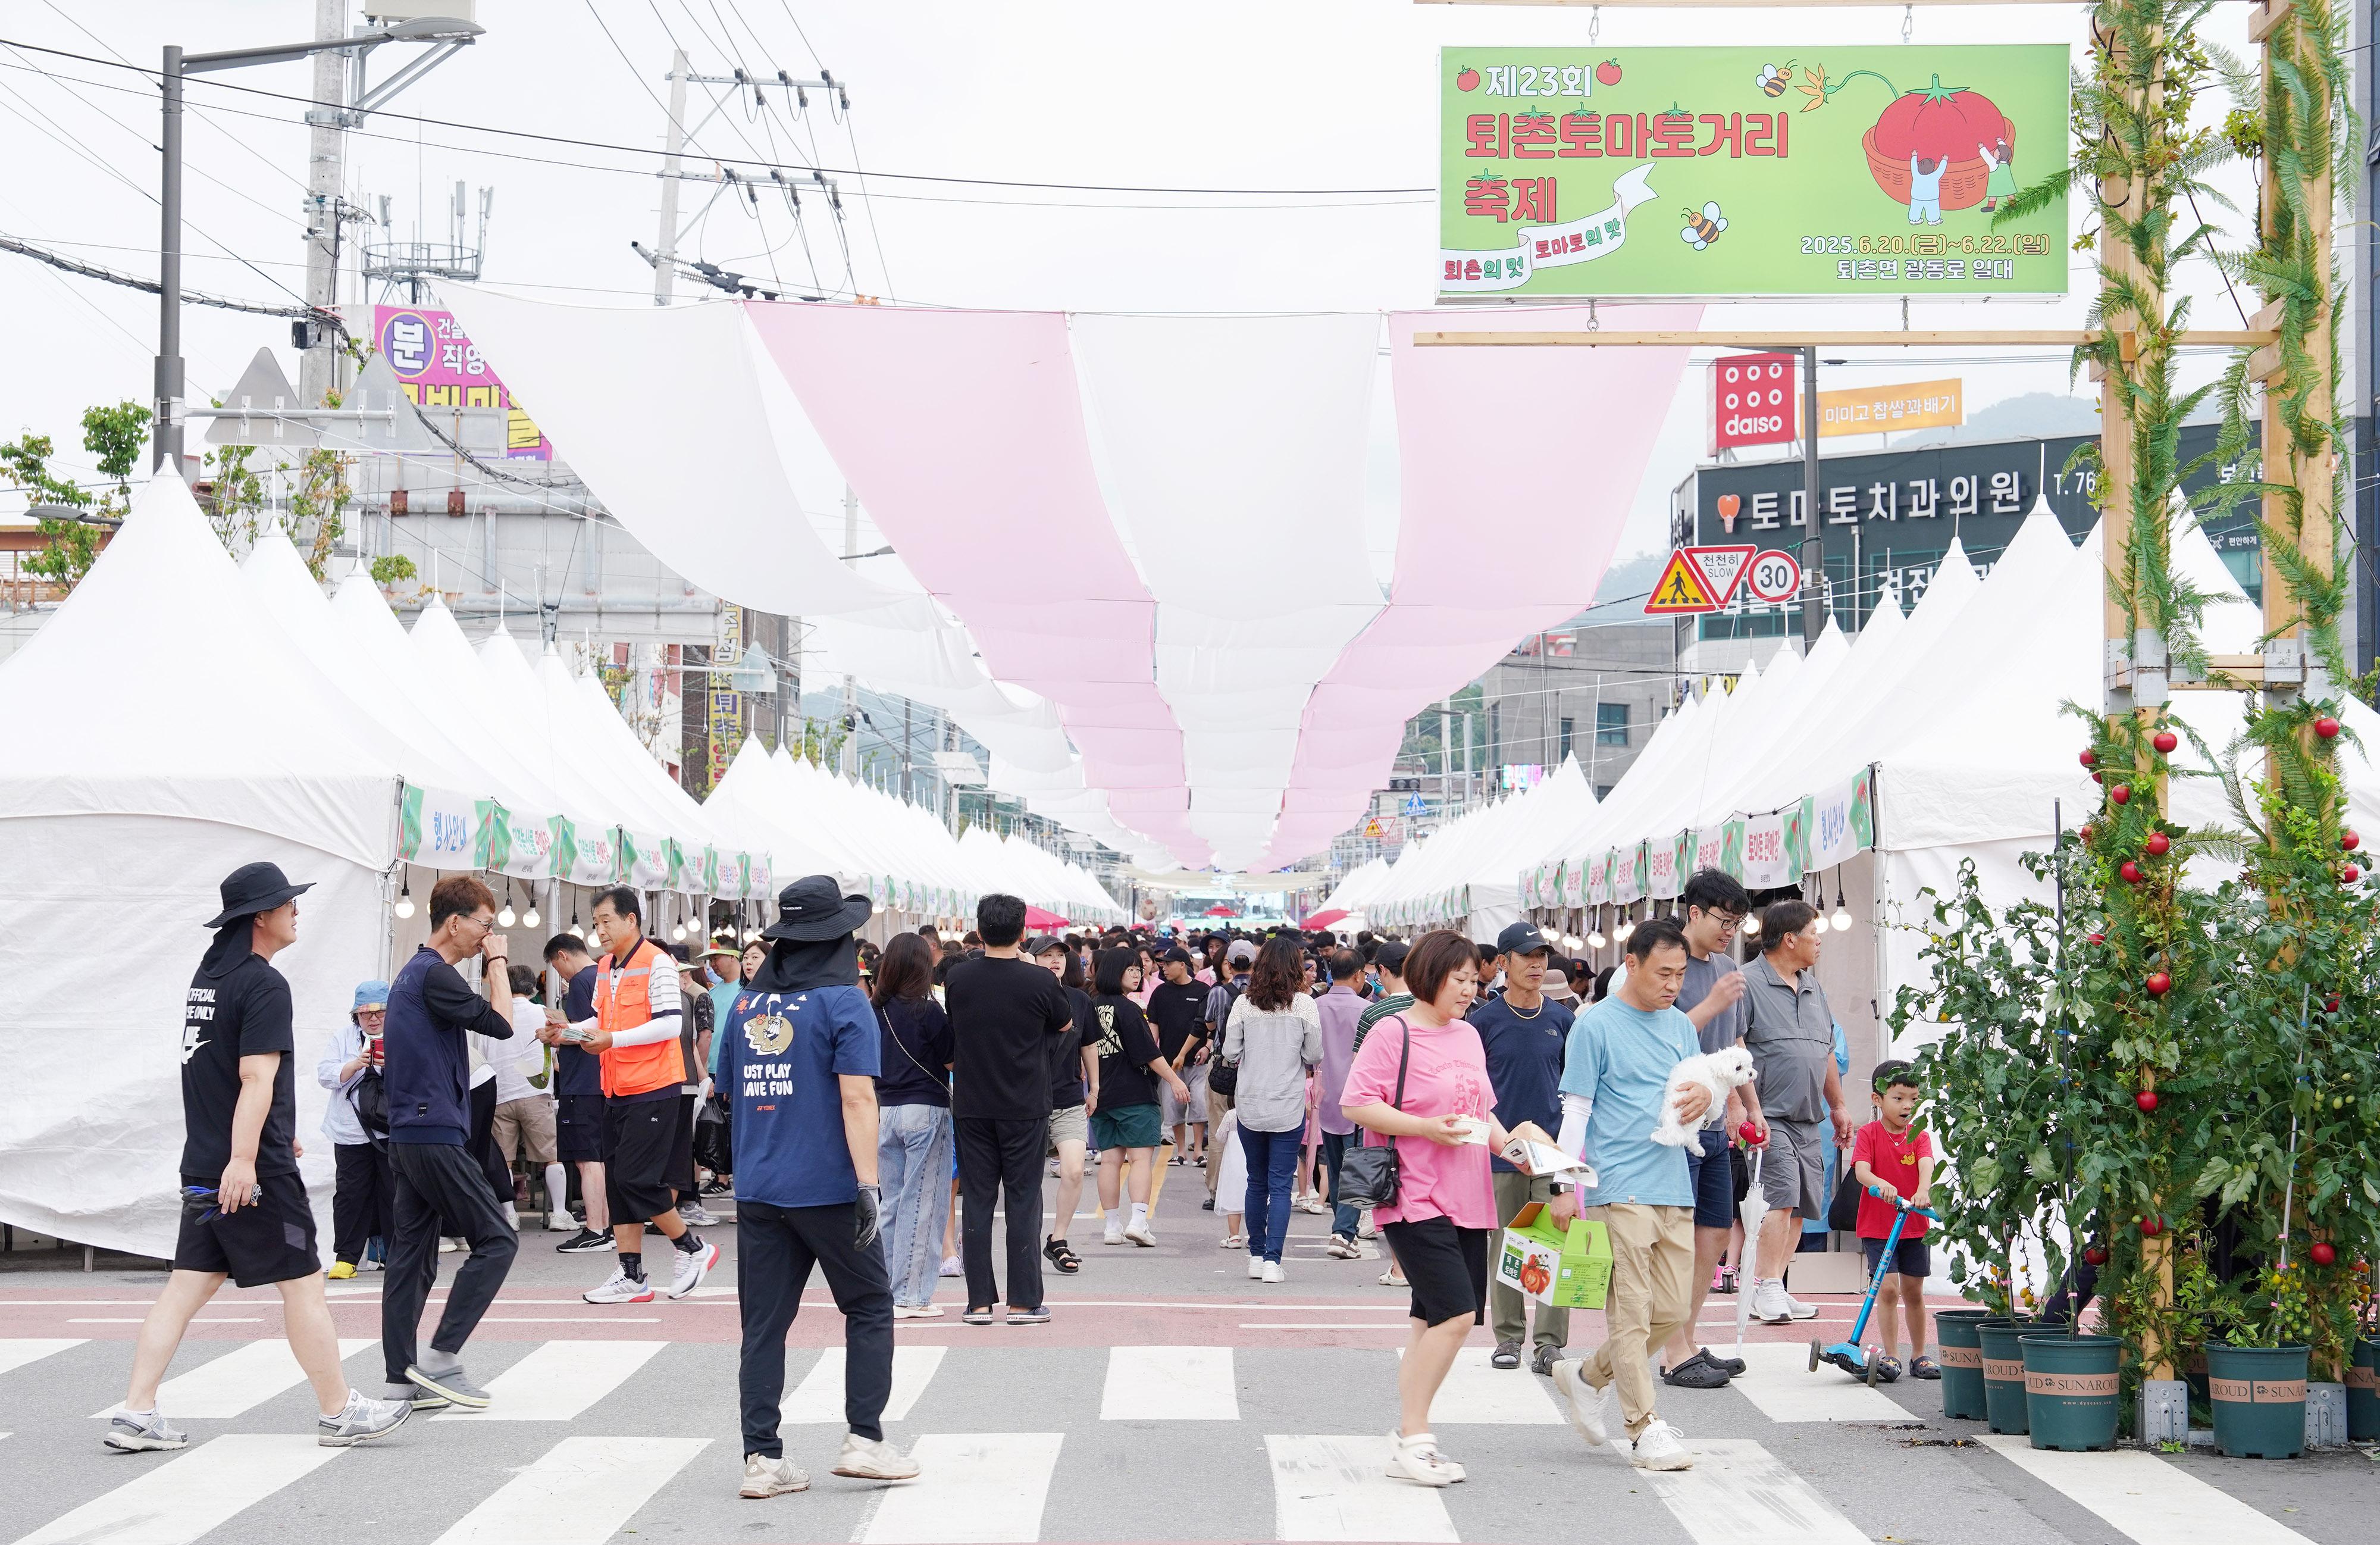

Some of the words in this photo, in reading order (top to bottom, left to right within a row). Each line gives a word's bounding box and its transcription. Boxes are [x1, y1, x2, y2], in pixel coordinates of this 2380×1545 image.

[1485, 65, 1592, 97] 제23회
[1465, 112, 1789, 159] 퇴촌토마토거리
[1464, 176, 1557, 223] 축제
[1536, 226, 1603, 259] 토마토의
[1604, 218, 1621, 240] 맛
[1800, 233, 2050, 256] 2025.6.20.(금)~6.22.(일)
[1444, 259, 1501, 280] 퇴촌의
[1506, 256, 1524, 279] 멋
[1837, 259, 1899, 280] 퇴촌면
[1904, 259, 1966, 280] 광동로
[1972, 259, 2013, 280] 일대
[392, 320, 425, 370] 분
[1725, 414, 1783, 436] daiso
[1825, 404, 1870, 425] 미미고
[2228, 535, 2257, 546] 편안하게
[1702, 554, 1739, 568] 천천히
[1708, 567, 1734, 578] SLOW
[1760, 565, 1788, 589] 30
[433, 811, 467, 852] 행사안내
[1821, 800, 1844, 851] 행사안내
[1748, 832, 1763, 862] 토마토
[1764, 828, 1780, 862] 판매장
[765, 1064, 791, 1079] PLAY
[769, 1080, 793, 1096] FUN
